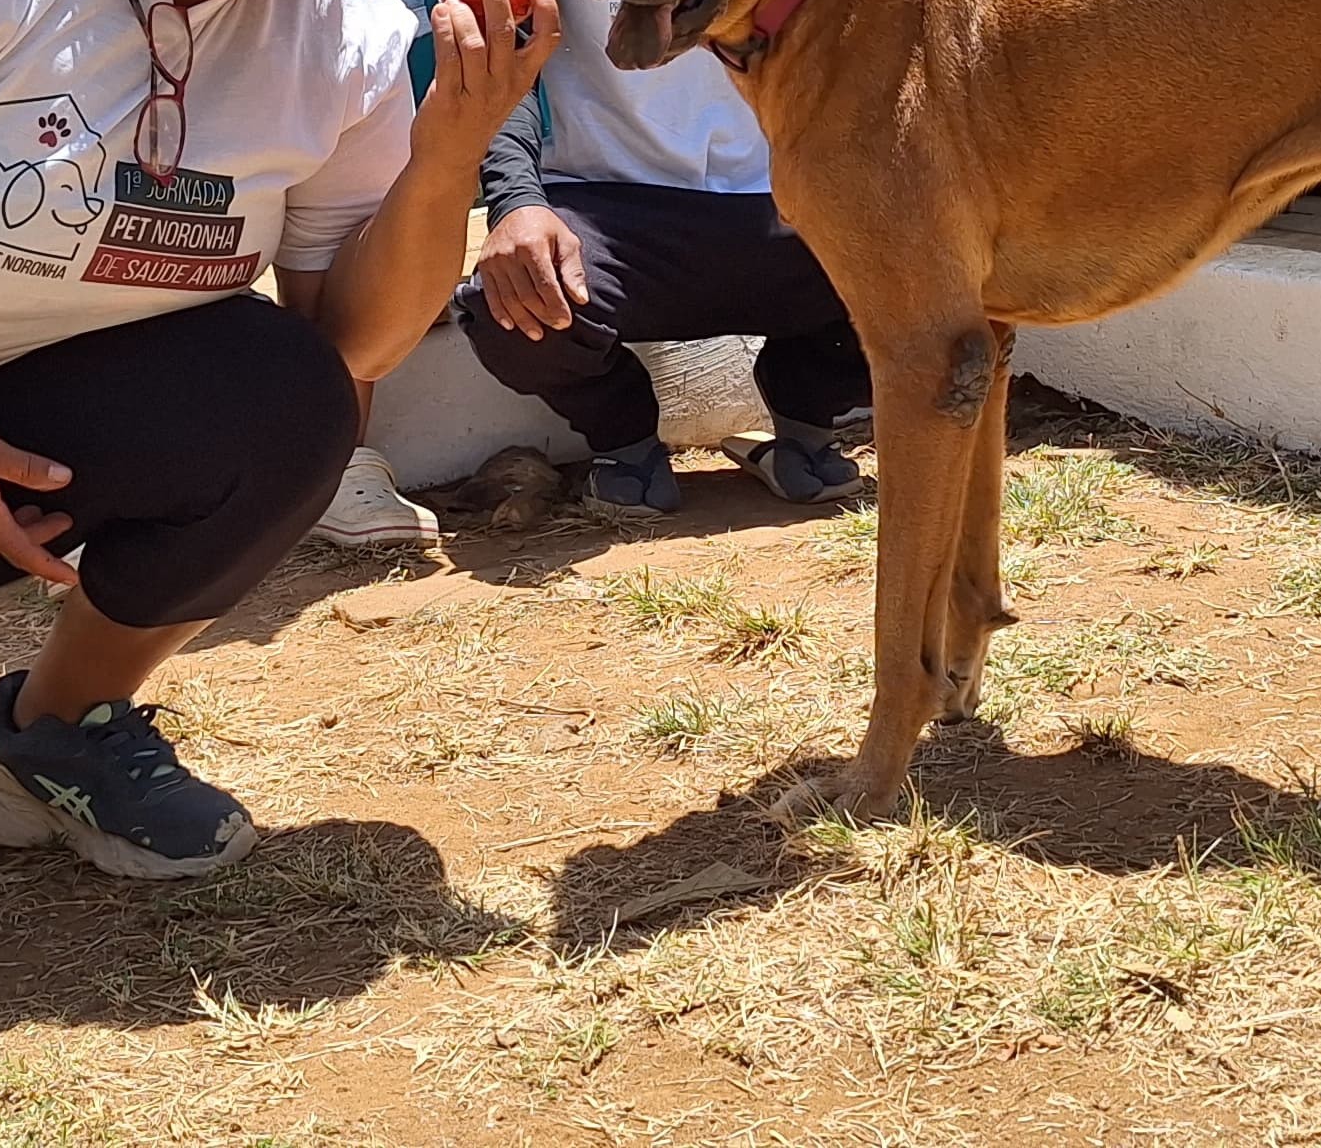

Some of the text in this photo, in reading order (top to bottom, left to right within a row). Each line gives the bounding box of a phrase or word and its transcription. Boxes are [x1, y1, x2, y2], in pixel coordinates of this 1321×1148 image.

[123, 170, 227, 207] 1ª JORNADA
[110, 213, 236, 250] PET NORONHA
[1, 254, 67, 280] NORONHA
[92, 253, 254, 286] DE SAÚDE ANIMAL
